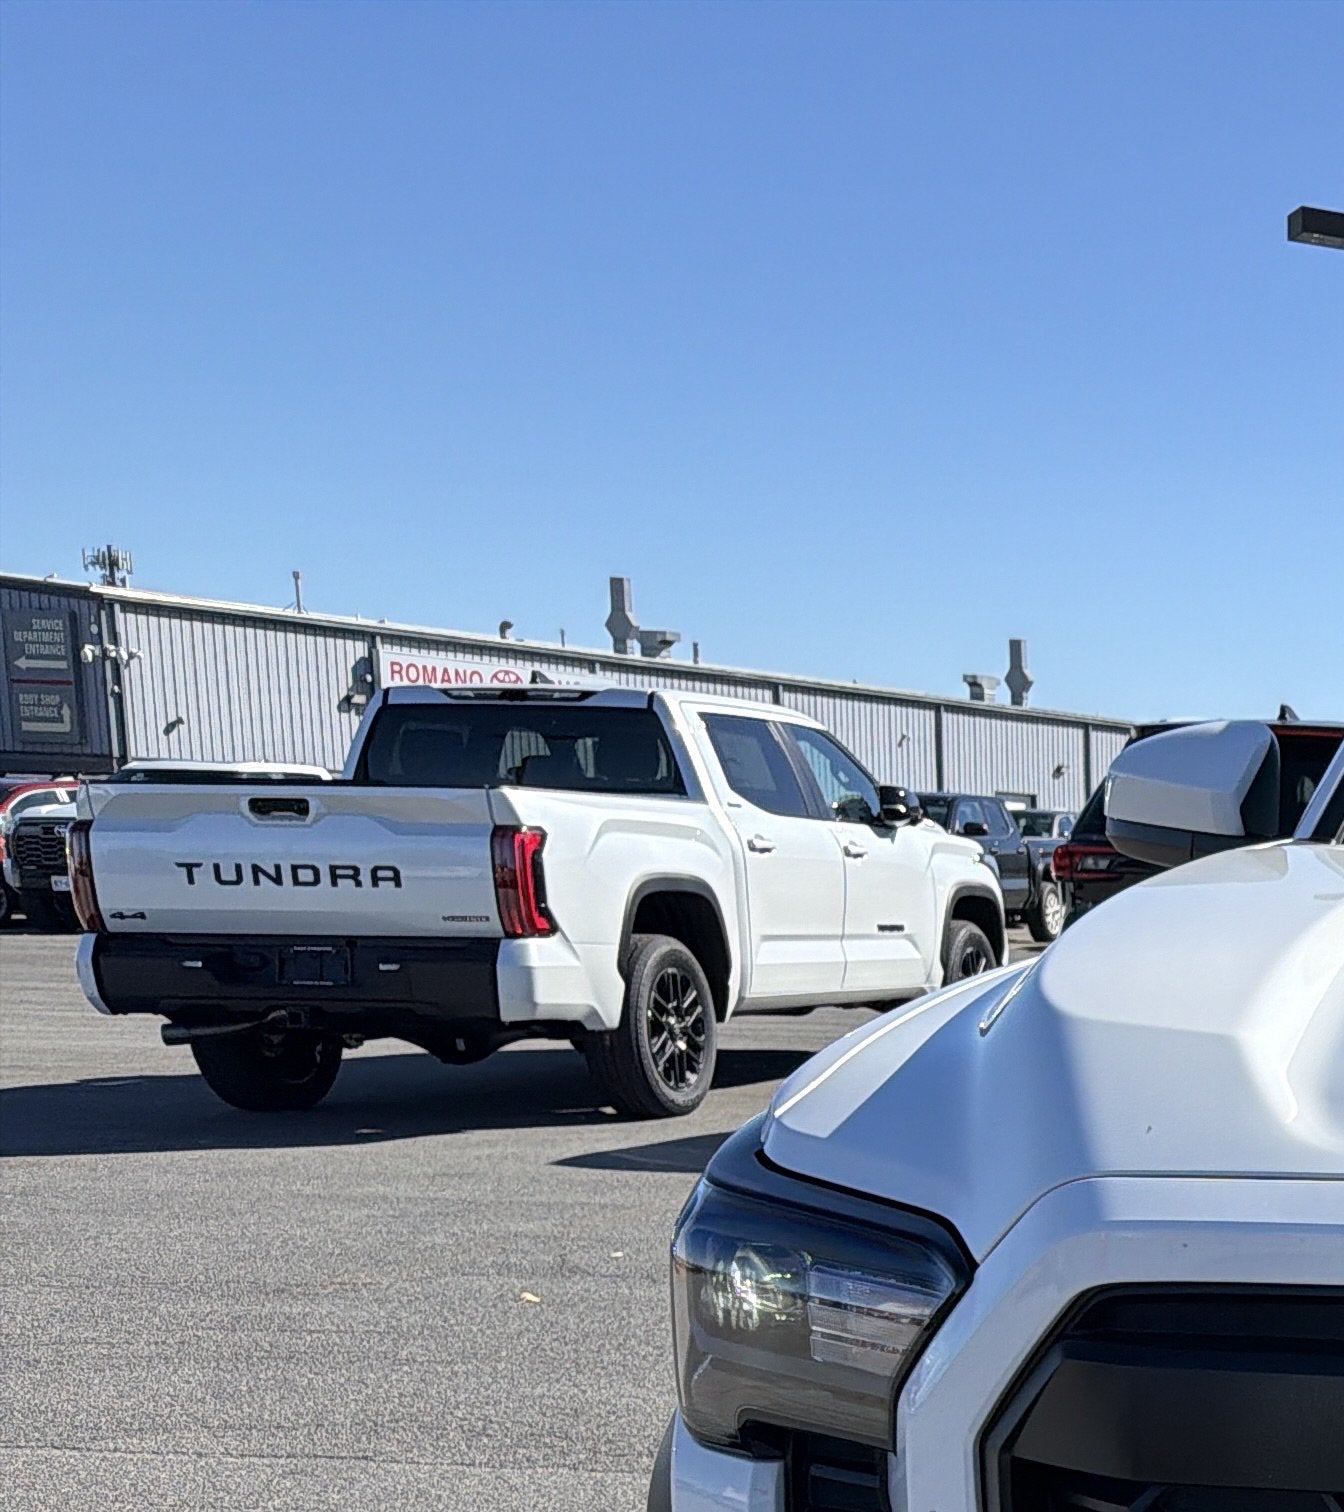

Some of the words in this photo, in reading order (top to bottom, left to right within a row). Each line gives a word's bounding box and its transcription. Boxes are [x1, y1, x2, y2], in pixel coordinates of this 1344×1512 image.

[31, 618, 64, 630] SERVICE
[13, 630, 65, 642] DEPARTMENT
[24, 643, 66, 655] ENTRANCE
[389, 660, 484, 684] ROMANO
[174, 861, 403, 889] TUNDRA
